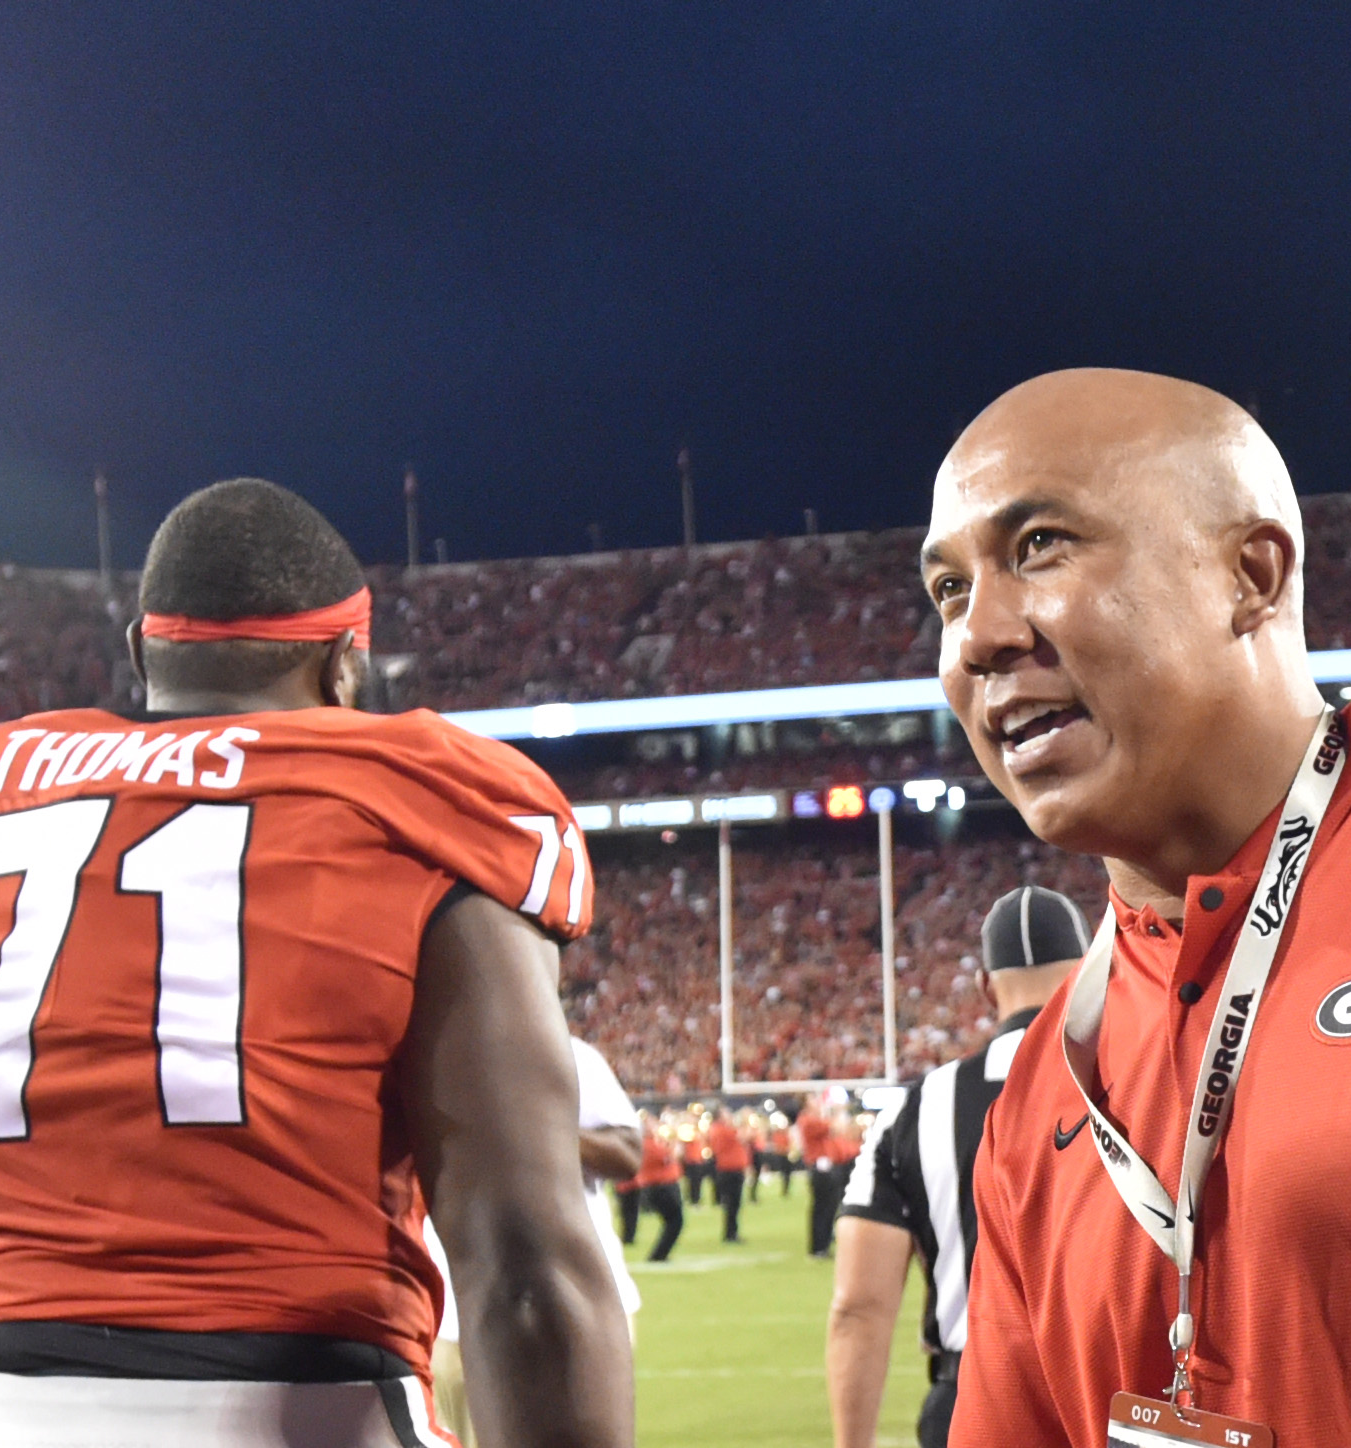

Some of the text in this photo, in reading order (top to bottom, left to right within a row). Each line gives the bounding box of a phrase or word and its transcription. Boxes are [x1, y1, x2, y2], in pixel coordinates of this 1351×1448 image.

[508, 814, 588, 926] 71
[1197, 988, 1255, 1138] GEORGIA
[1131, 1405, 1161, 1425] 007
[1225, 1428, 1252, 1447] 1ST
